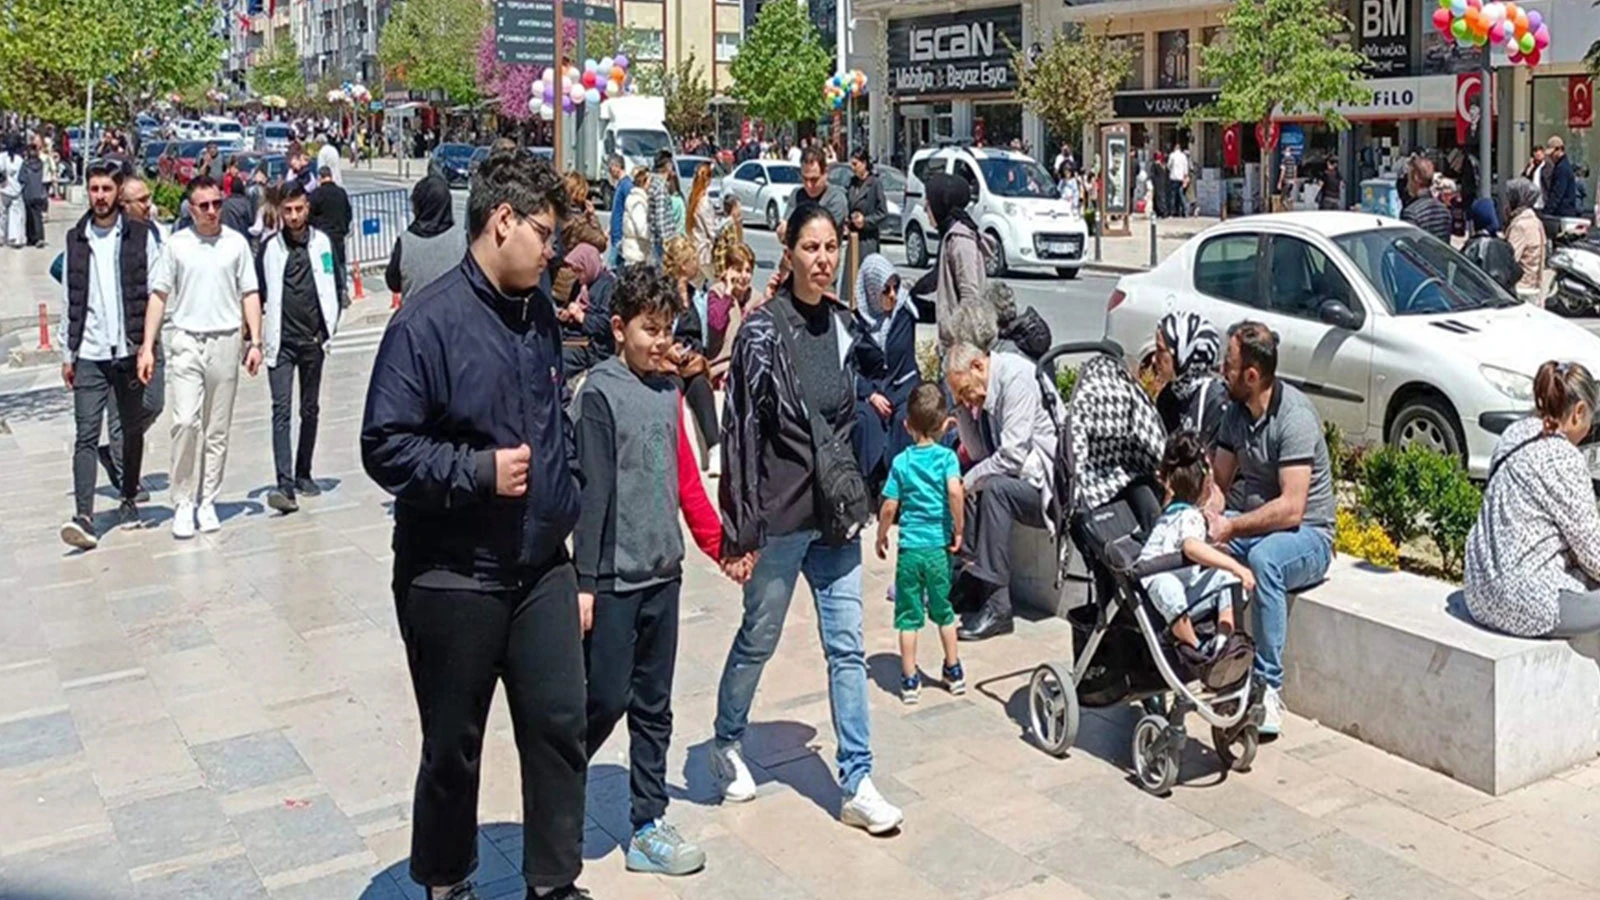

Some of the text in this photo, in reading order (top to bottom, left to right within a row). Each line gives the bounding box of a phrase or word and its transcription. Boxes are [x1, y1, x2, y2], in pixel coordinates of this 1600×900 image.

[1362, 0, 1406, 37] BM
[946, 64, 980, 90] Beyaz
[1337, 89, 1414, 108] FiLO
